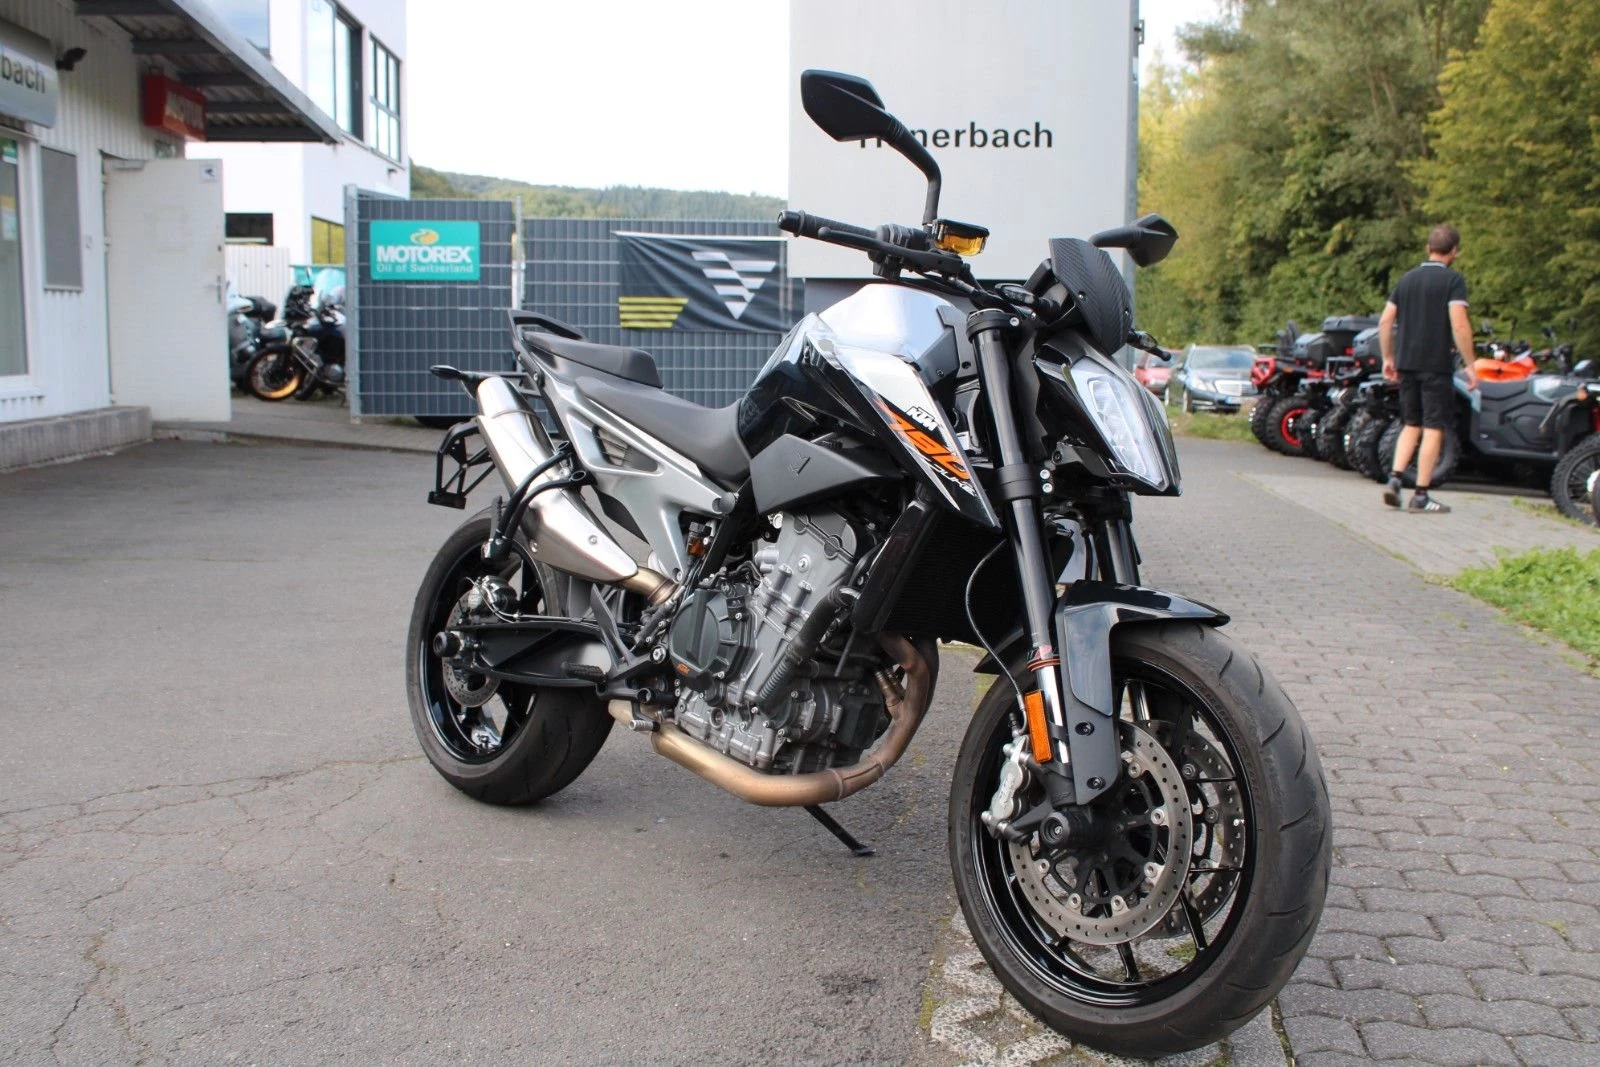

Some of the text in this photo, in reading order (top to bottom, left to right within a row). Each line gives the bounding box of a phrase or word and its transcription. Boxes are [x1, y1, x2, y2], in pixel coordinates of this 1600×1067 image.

[376, 245, 473, 263] MOTOREX
[376, 264, 474, 273] Oil of Switzerland
[905, 406, 938, 432] KTM
